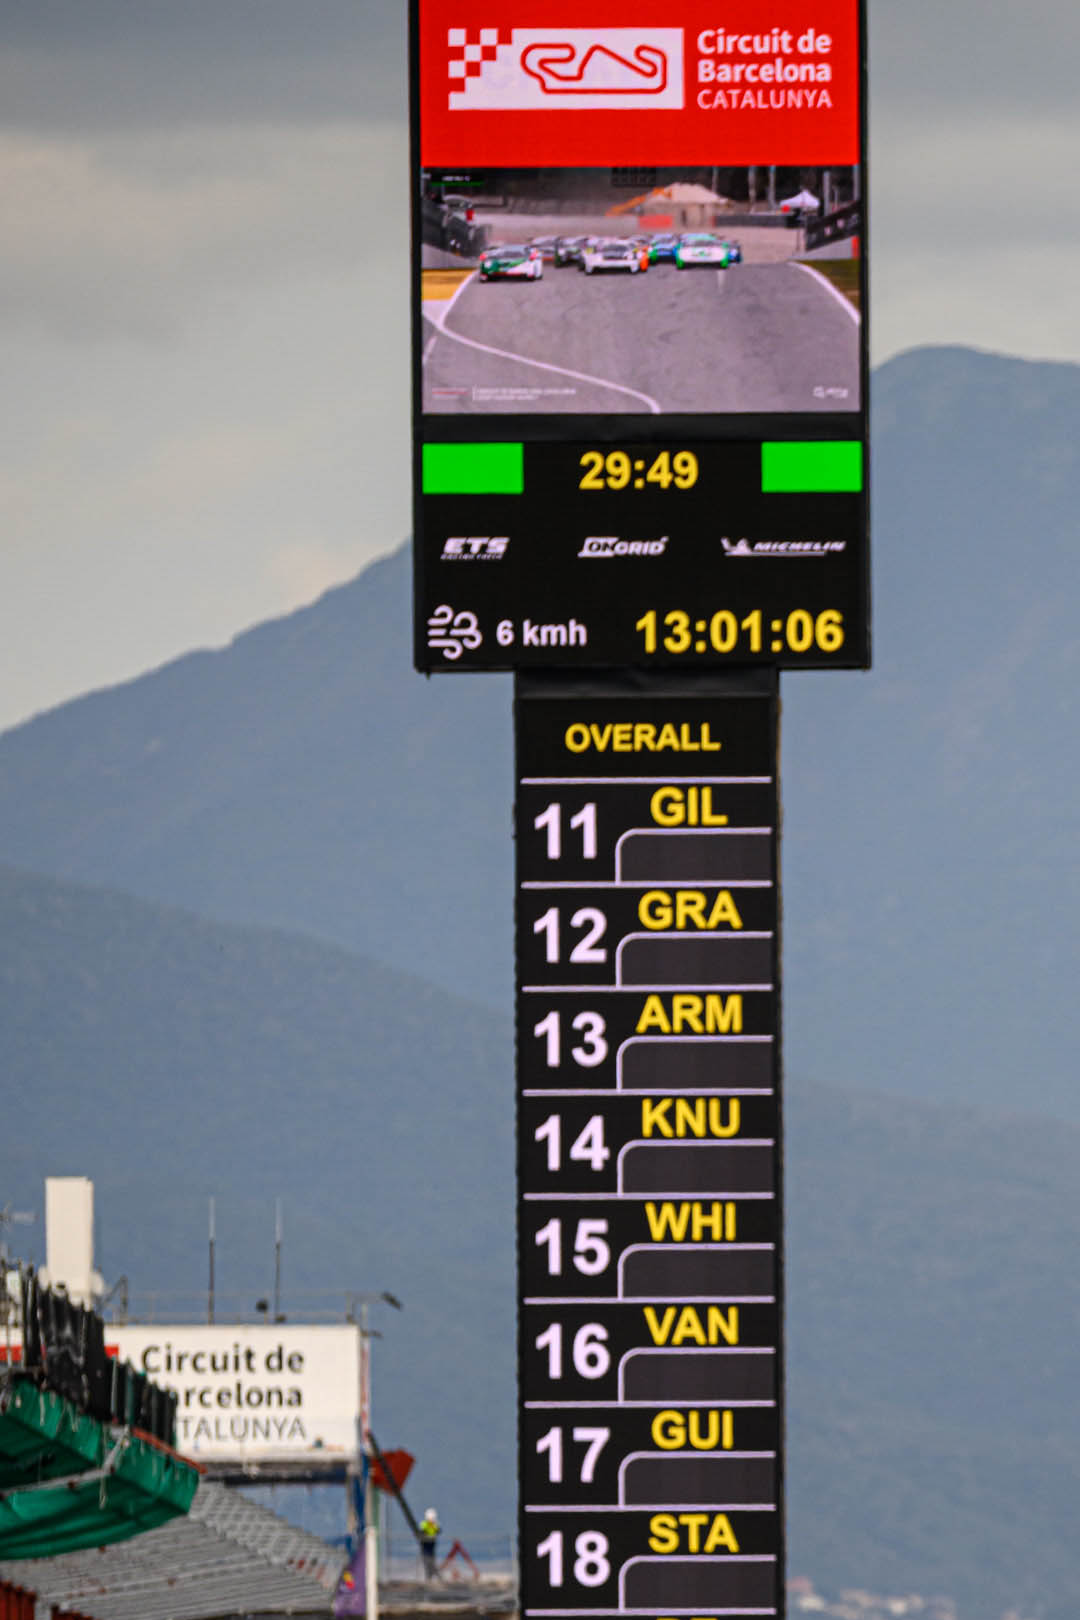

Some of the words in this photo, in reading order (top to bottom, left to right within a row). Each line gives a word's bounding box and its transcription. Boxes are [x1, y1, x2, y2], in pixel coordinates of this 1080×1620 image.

[697, 28, 791, 54] Circuit
[801, 28, 832, 54] de
[697, 59, 831, 83] Barcelona
[697, 89, 833, 109] CATALUNYA
[579, 450, 699, 490] 29:49
[443, 536, 509, 553] ETS
[753, 541, 847, 552] MICHELIN
[496, 620, 514, 646] 6
[523, 619, 588, 646] kmh
[635, 609, 844, 654] 13:01:06
[565, 723, 721, 752] OVERALL
[534, 803, 597, 858] 11
[651, 787, 728, 826] GIL
[533, 907, 607, 963] 12
[638, 890, 743, 930] GRA
[534, 1011, 608, 1067] 13
[636, 995, 743, 1033] ARM
[534, 1115, 610, 1171] 14
[641, 1098, 740, 1138] KNU
[535, 1219, 610, 1275] 15
[645, 1202, 737, 1242] WHI
[141, 1344, 256, 1374] Circuit
[264, 1345, 305, 1373] de
[535, 1323, 610, 1379] 16
[643, 1306, 739, 1346] VAN
[536, 1427, 610, 1483] 17
[651, 1410, 734, 1450] GUI
[537, 1531, 610, 1587] 18
[648, 1514, 739, 1554] STA
